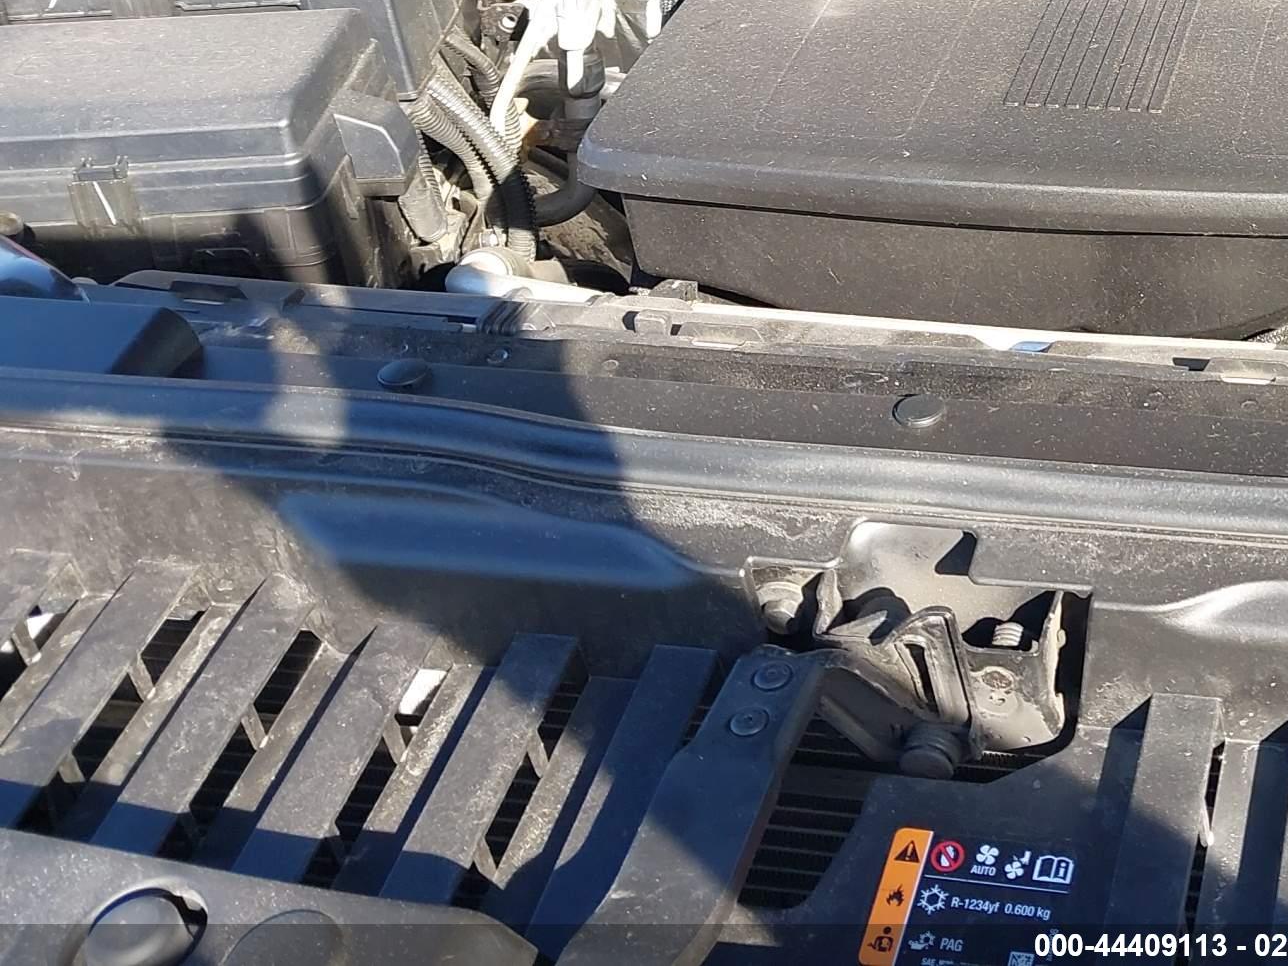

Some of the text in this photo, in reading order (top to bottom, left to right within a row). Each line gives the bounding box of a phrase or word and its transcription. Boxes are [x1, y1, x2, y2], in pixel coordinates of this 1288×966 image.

[970, 865, 997, 876] AUTO
[951, 897, 1051, 921] R-1234yf 0.600 kg
[939, 938, 964, 952] PAG
